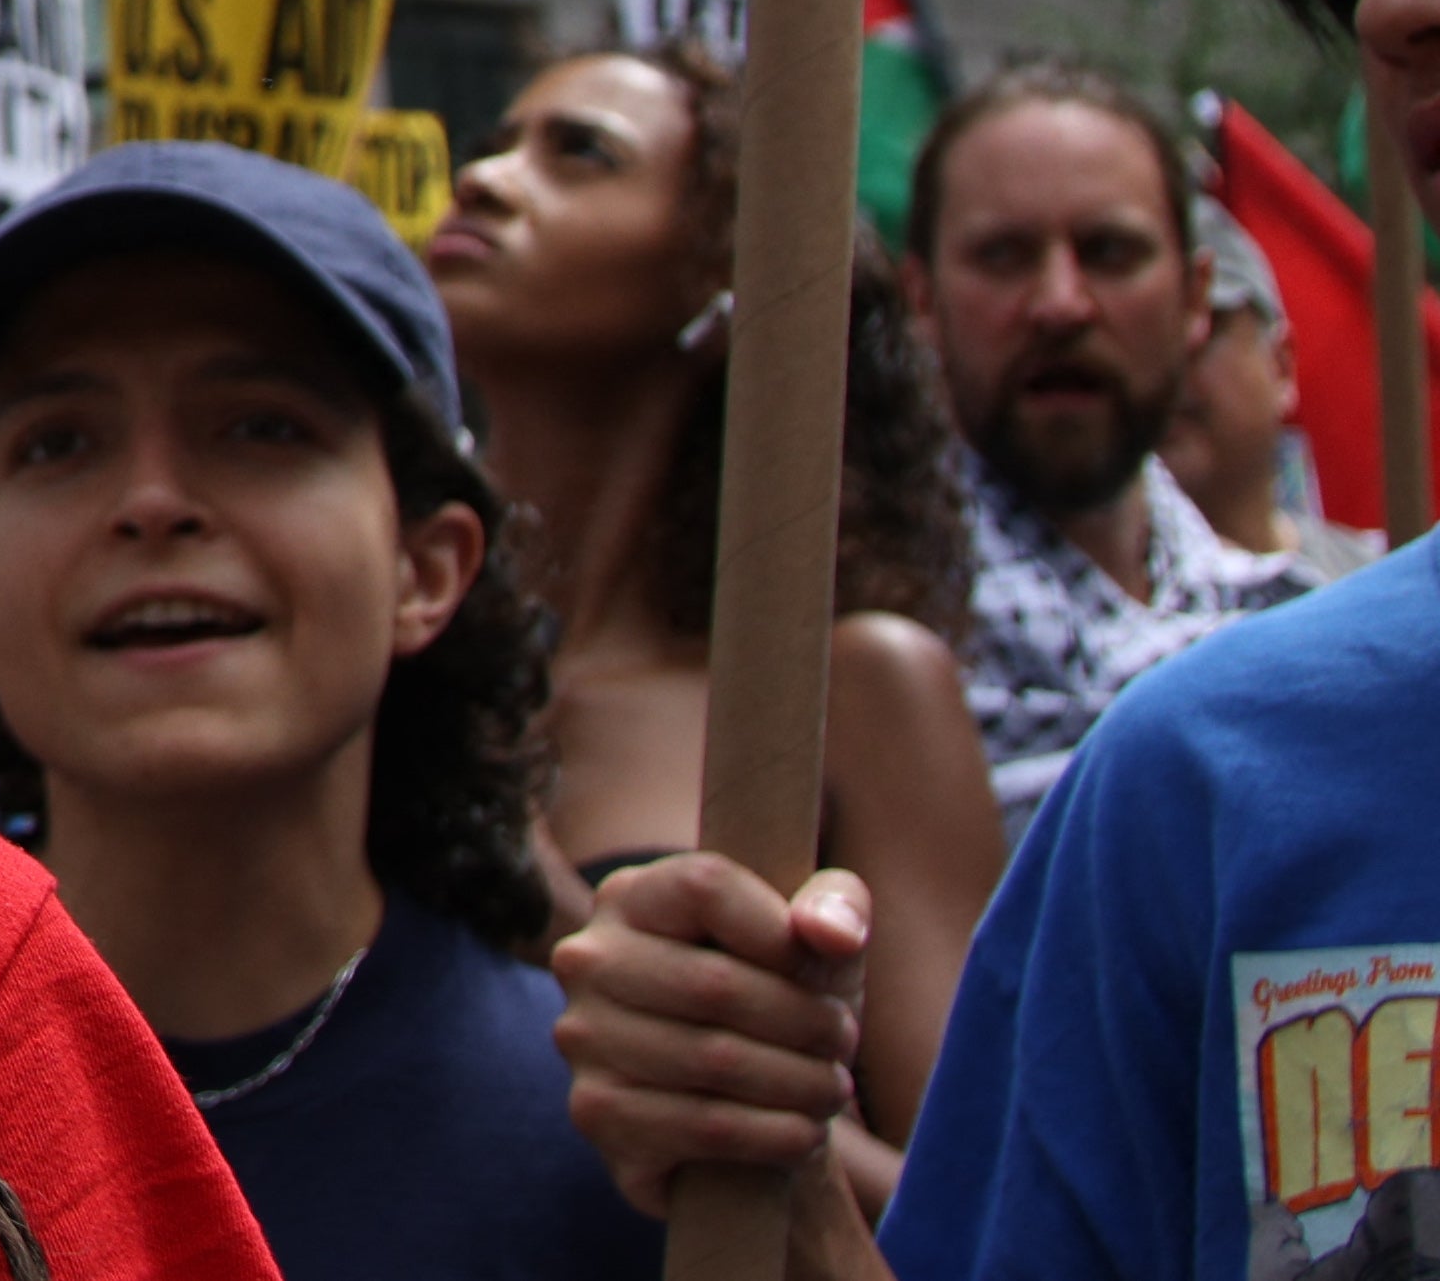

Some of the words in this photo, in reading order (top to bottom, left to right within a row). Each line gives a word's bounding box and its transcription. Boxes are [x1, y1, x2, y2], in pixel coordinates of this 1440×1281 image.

[1252, 966, 1359, 1024] Greetings
[1366, 953, 1437, 987] From
[1257, 995, 1440, 1216] NE
